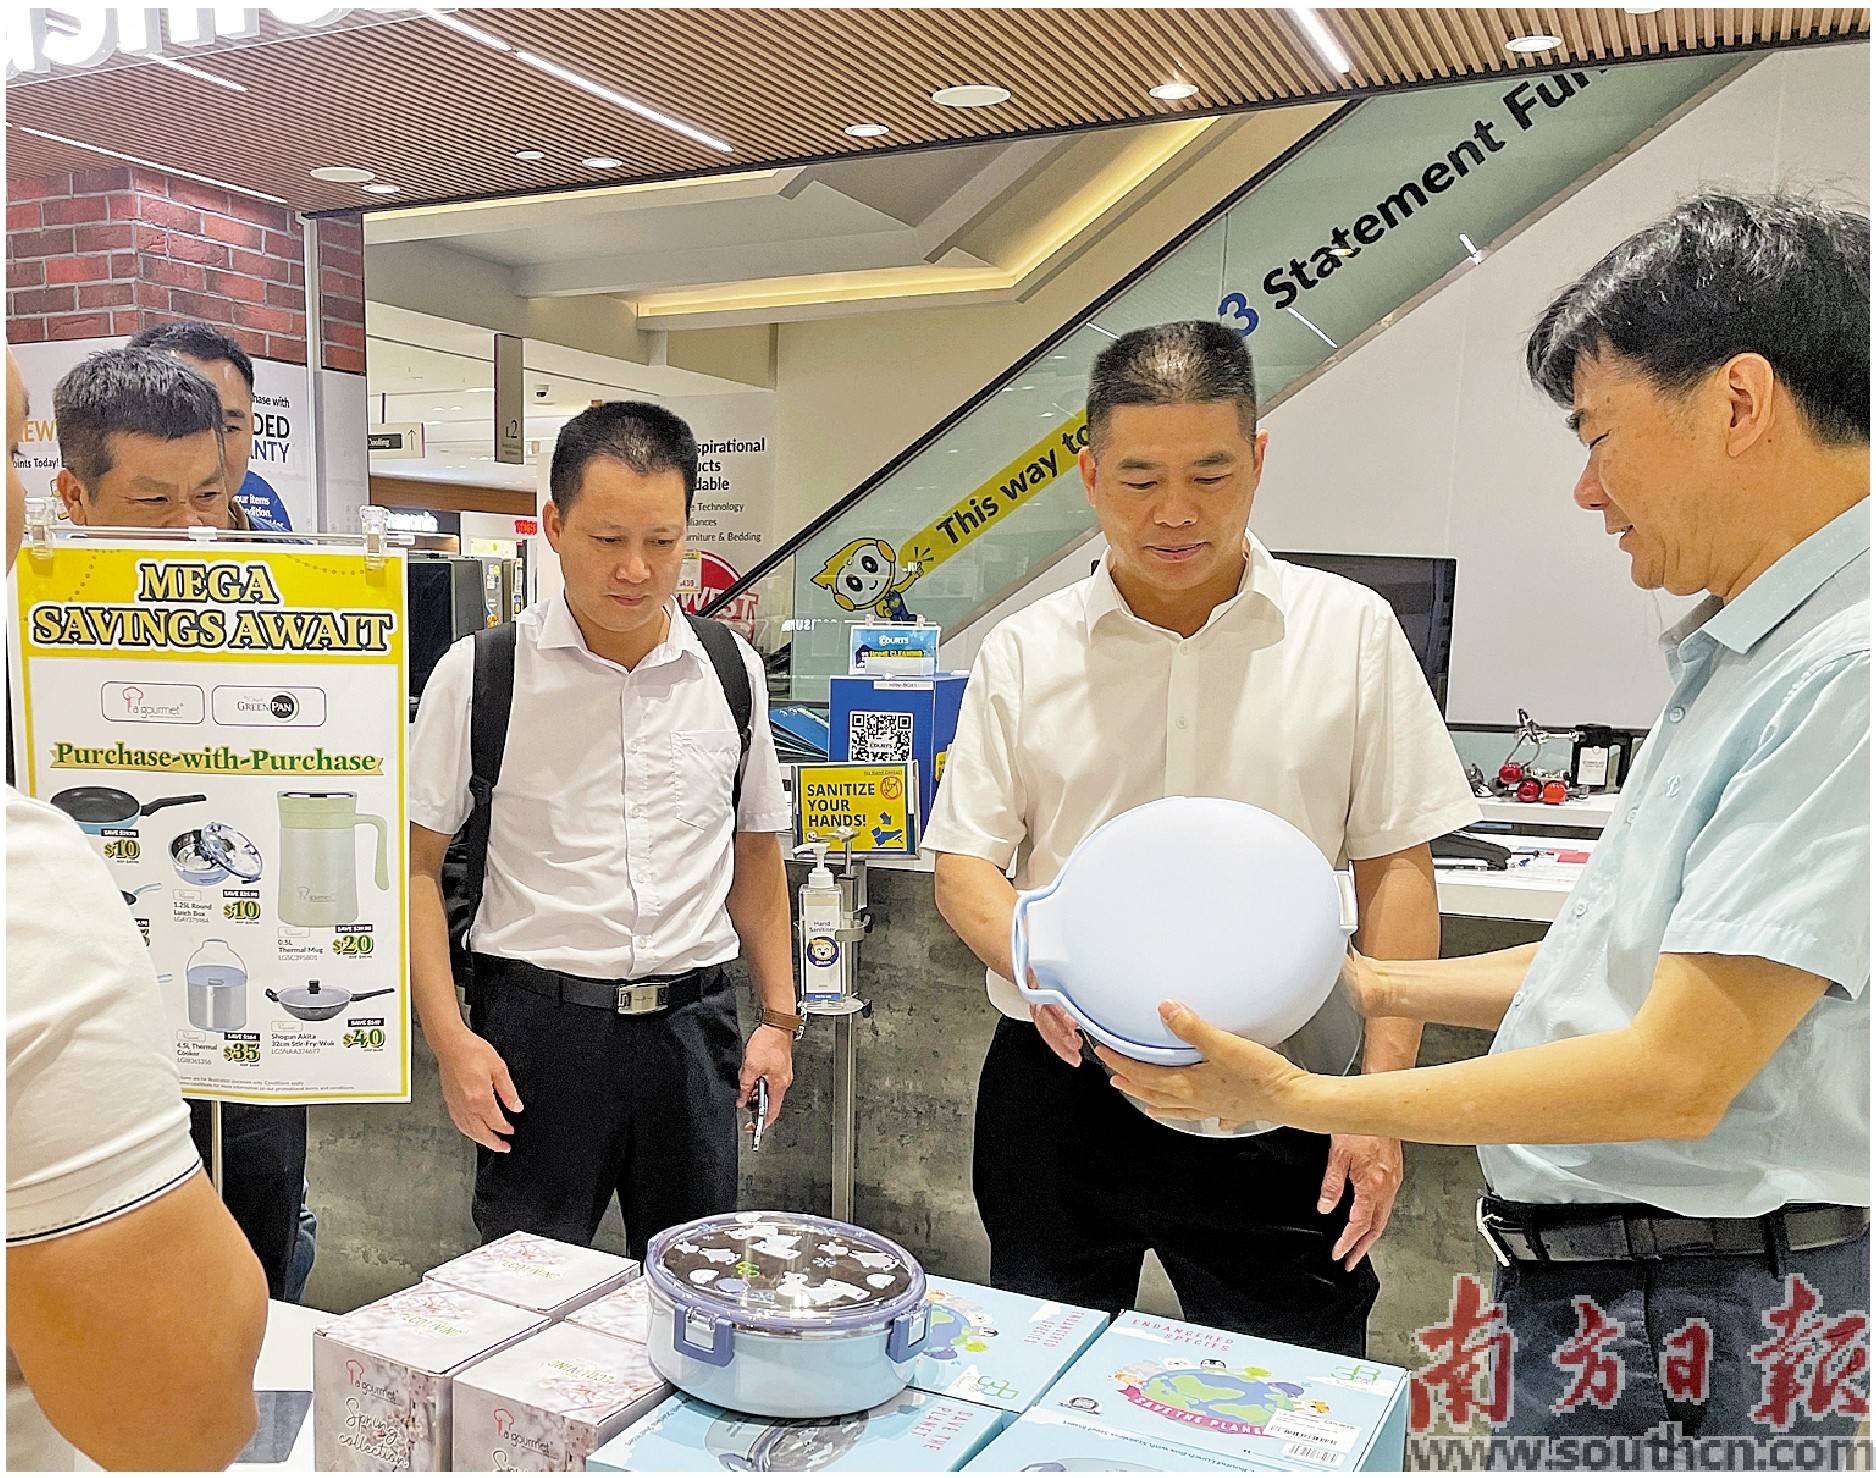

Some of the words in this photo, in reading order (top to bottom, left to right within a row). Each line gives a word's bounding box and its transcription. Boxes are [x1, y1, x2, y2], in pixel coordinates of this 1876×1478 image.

[936, 496, 1000, 544] This
[1000, 448, 1057, 500] way
[1263, 120, 1505, 310] Statement
[272, 396, 290, 408] with
[251, 440, 290, 463] NTY
[34, 458, 58, 469] Today!
[698, 502, 744, 513] Technology
[719, 532, 725, 541] &
[727, 532, 761, 542] Bedding
[139, 563, 280, 604] MEGA
[33, 606, 228, 646] SAVINGS
[228, 610, 393, 651] AWAIT
[56, 741, 377, 772] Purchase-with-Purchase
[807, 783, 875, 797] SANITIZE
[808, 799, 850, 812] YOUR
[808, 813, 866, 828] HANDS!
[104, 838, 141, 859] $10
[223, 900, 261, 920] $10
[332, 934, 374, 955] $20
[343, 1028, 385, 1048] $40
[223, 1043, 261, 1062] $35
[1132, 1319, 1234, 1344] ENDANGERED
[345, 1398, 398, 1445] Spring
[1134, 1397, 1172, 1414] SAVE
[1176, 1411, 1202, 1424] THE
[1209, 1419, 1264, 1435] PLANE
[339, 1433, 410, 1469] collection
